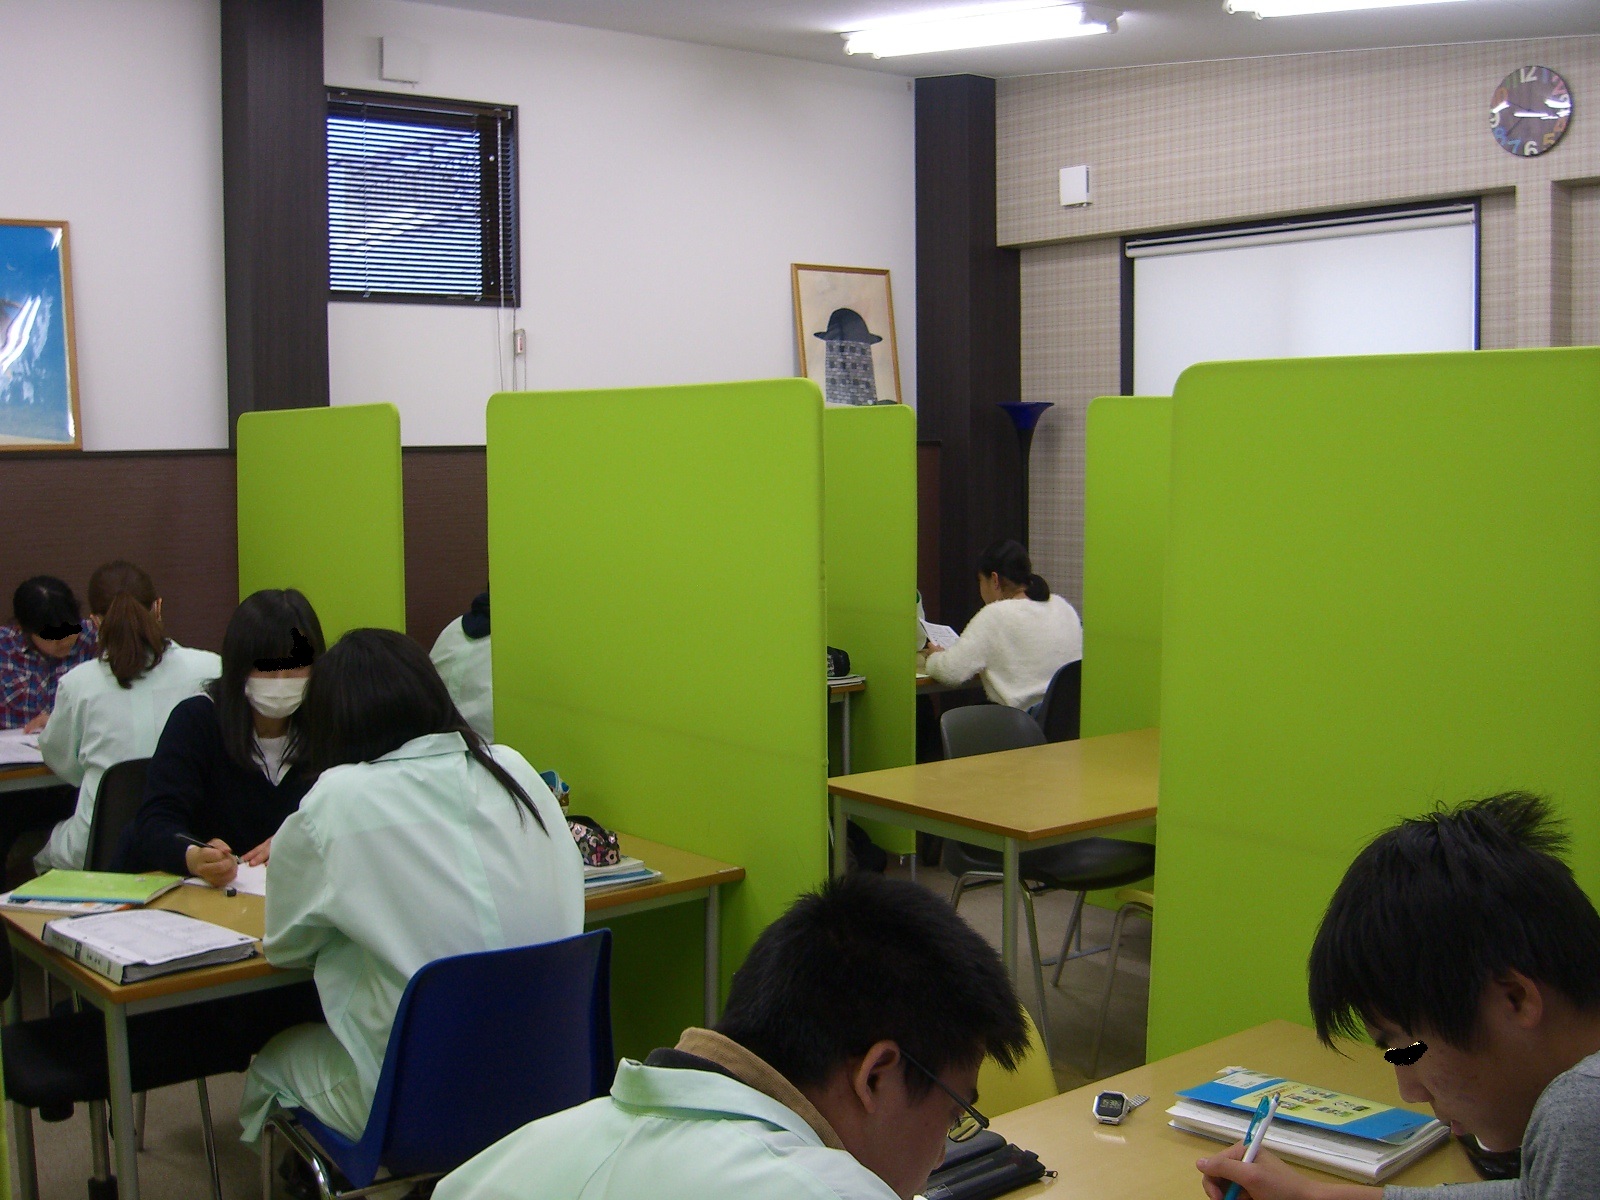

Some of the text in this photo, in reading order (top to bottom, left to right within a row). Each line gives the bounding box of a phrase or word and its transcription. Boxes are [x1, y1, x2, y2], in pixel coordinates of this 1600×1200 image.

[1520, 66, 1537, 83] 12
[1551, 75, 1567, 95] 2
[1489, 109, 1500, 128] 9
[1493, 127, 1508, 145] 8
[1508, 139, 1522, 154] 7
[1524, 140, 1538, 155] 6
